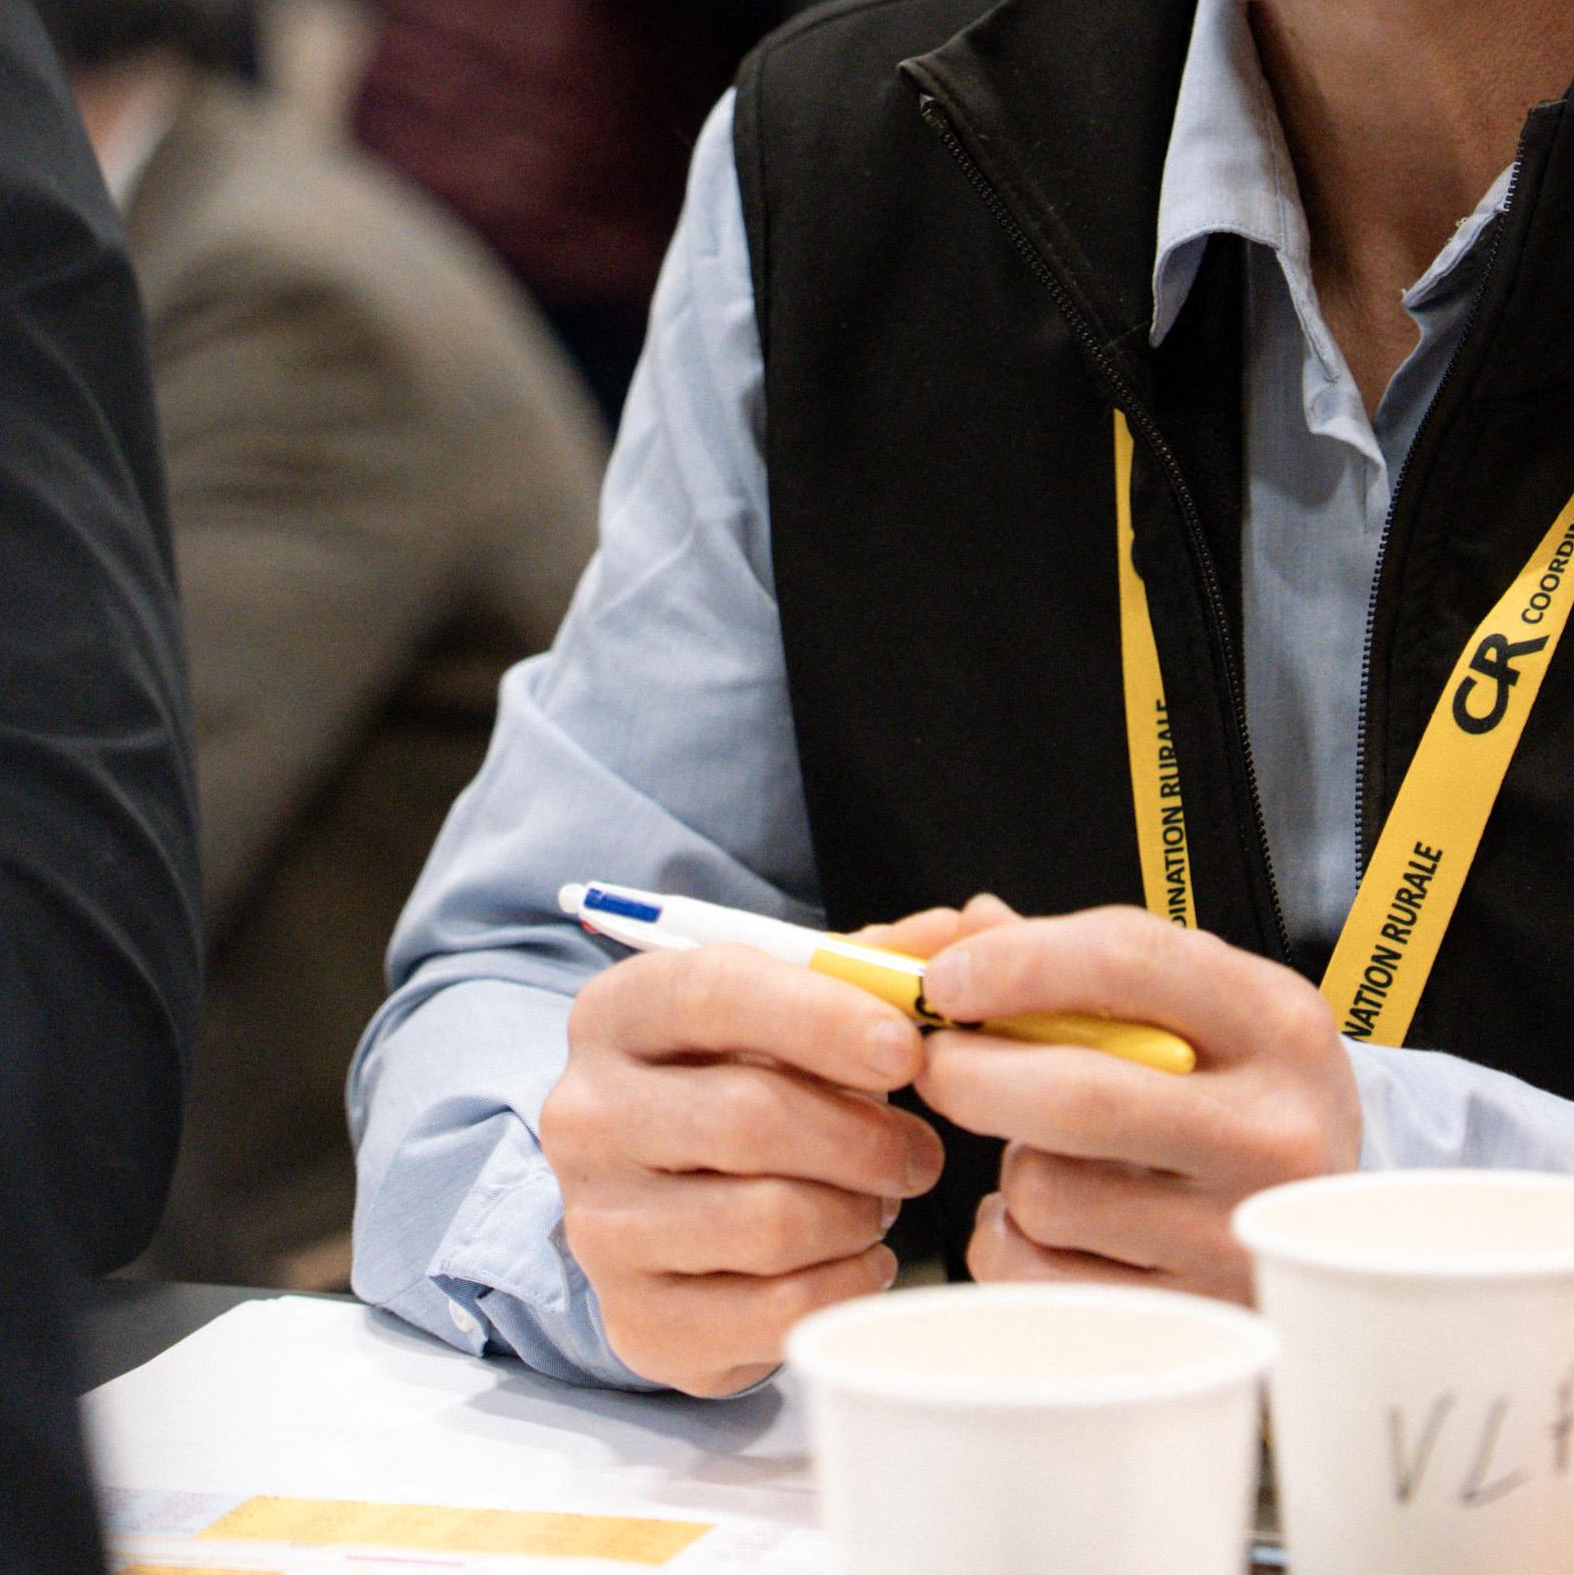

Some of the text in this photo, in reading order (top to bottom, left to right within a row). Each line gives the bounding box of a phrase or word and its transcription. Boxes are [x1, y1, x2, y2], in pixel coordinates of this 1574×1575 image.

[1452, 633, 1550, 735] CR
[1341, 841, 1444, 1043] NATION RURALE
